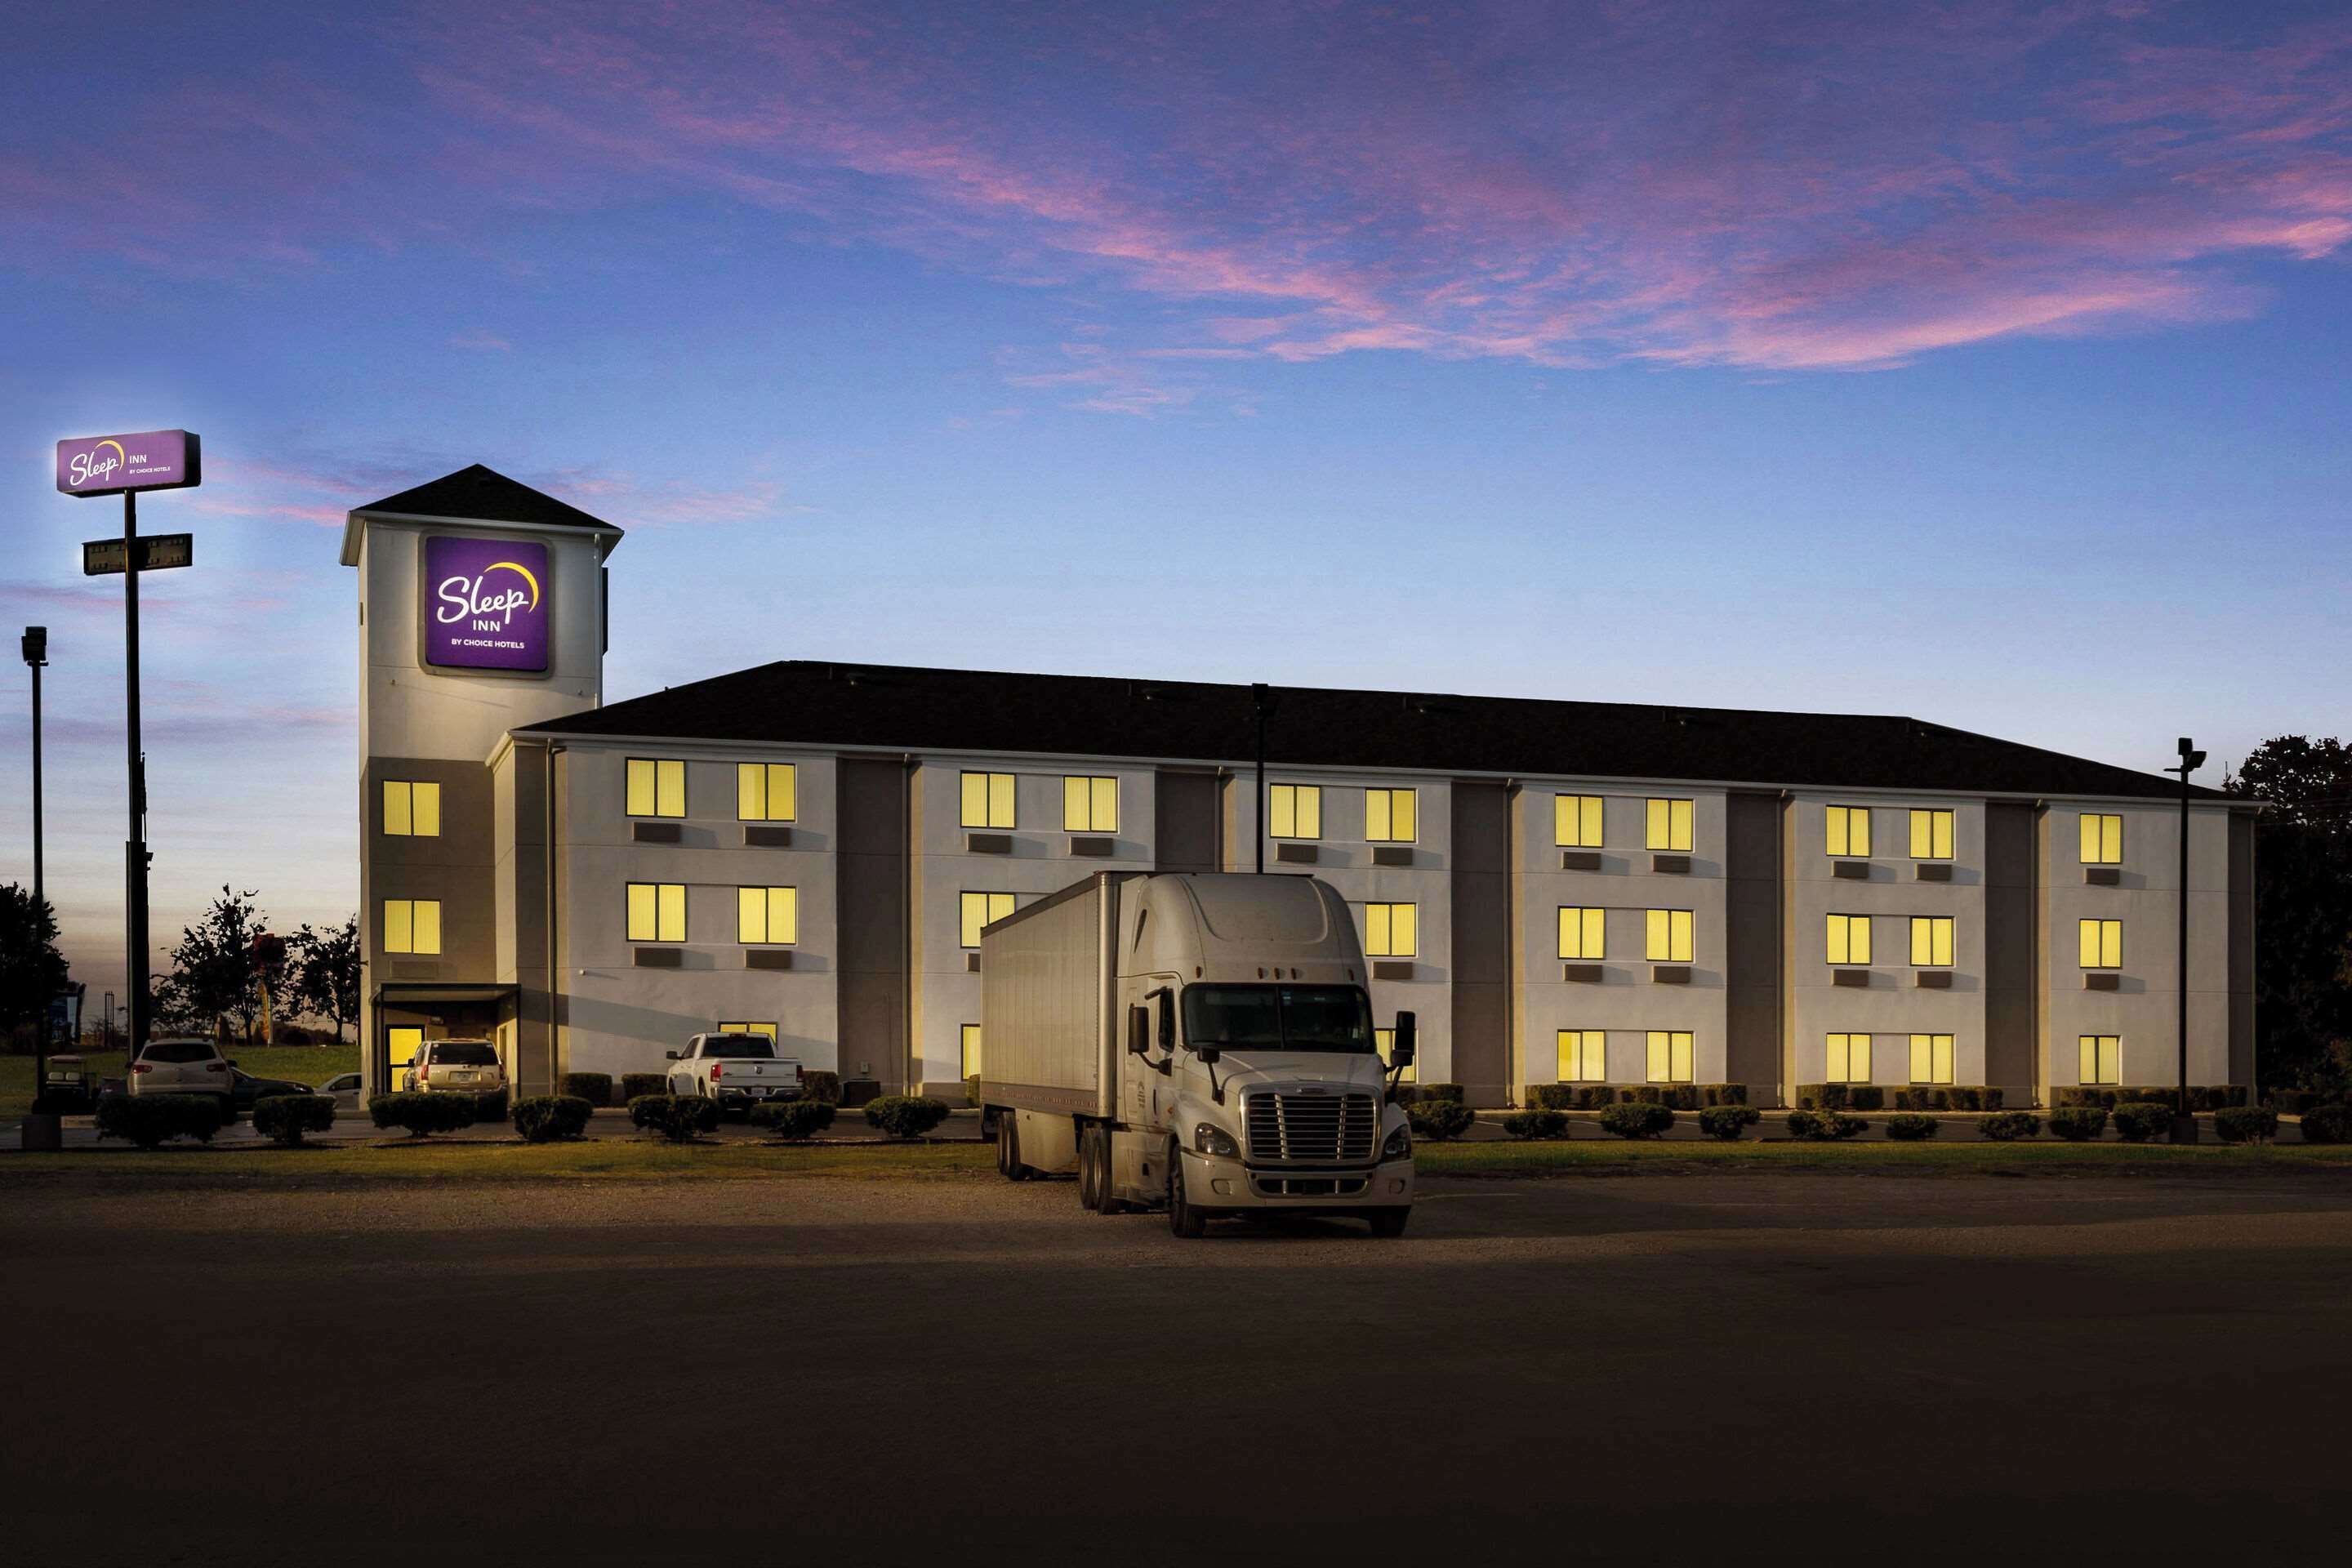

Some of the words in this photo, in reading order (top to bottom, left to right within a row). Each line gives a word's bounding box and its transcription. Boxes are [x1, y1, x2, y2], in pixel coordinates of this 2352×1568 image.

[129, 454, 147, 464] INN
[69, 451, 119, 486] Sleep
[437, 575, 529, 625] Sleep
[472, 619, 501, 632] INN
[463, 639, 493, 647] CHOICE
